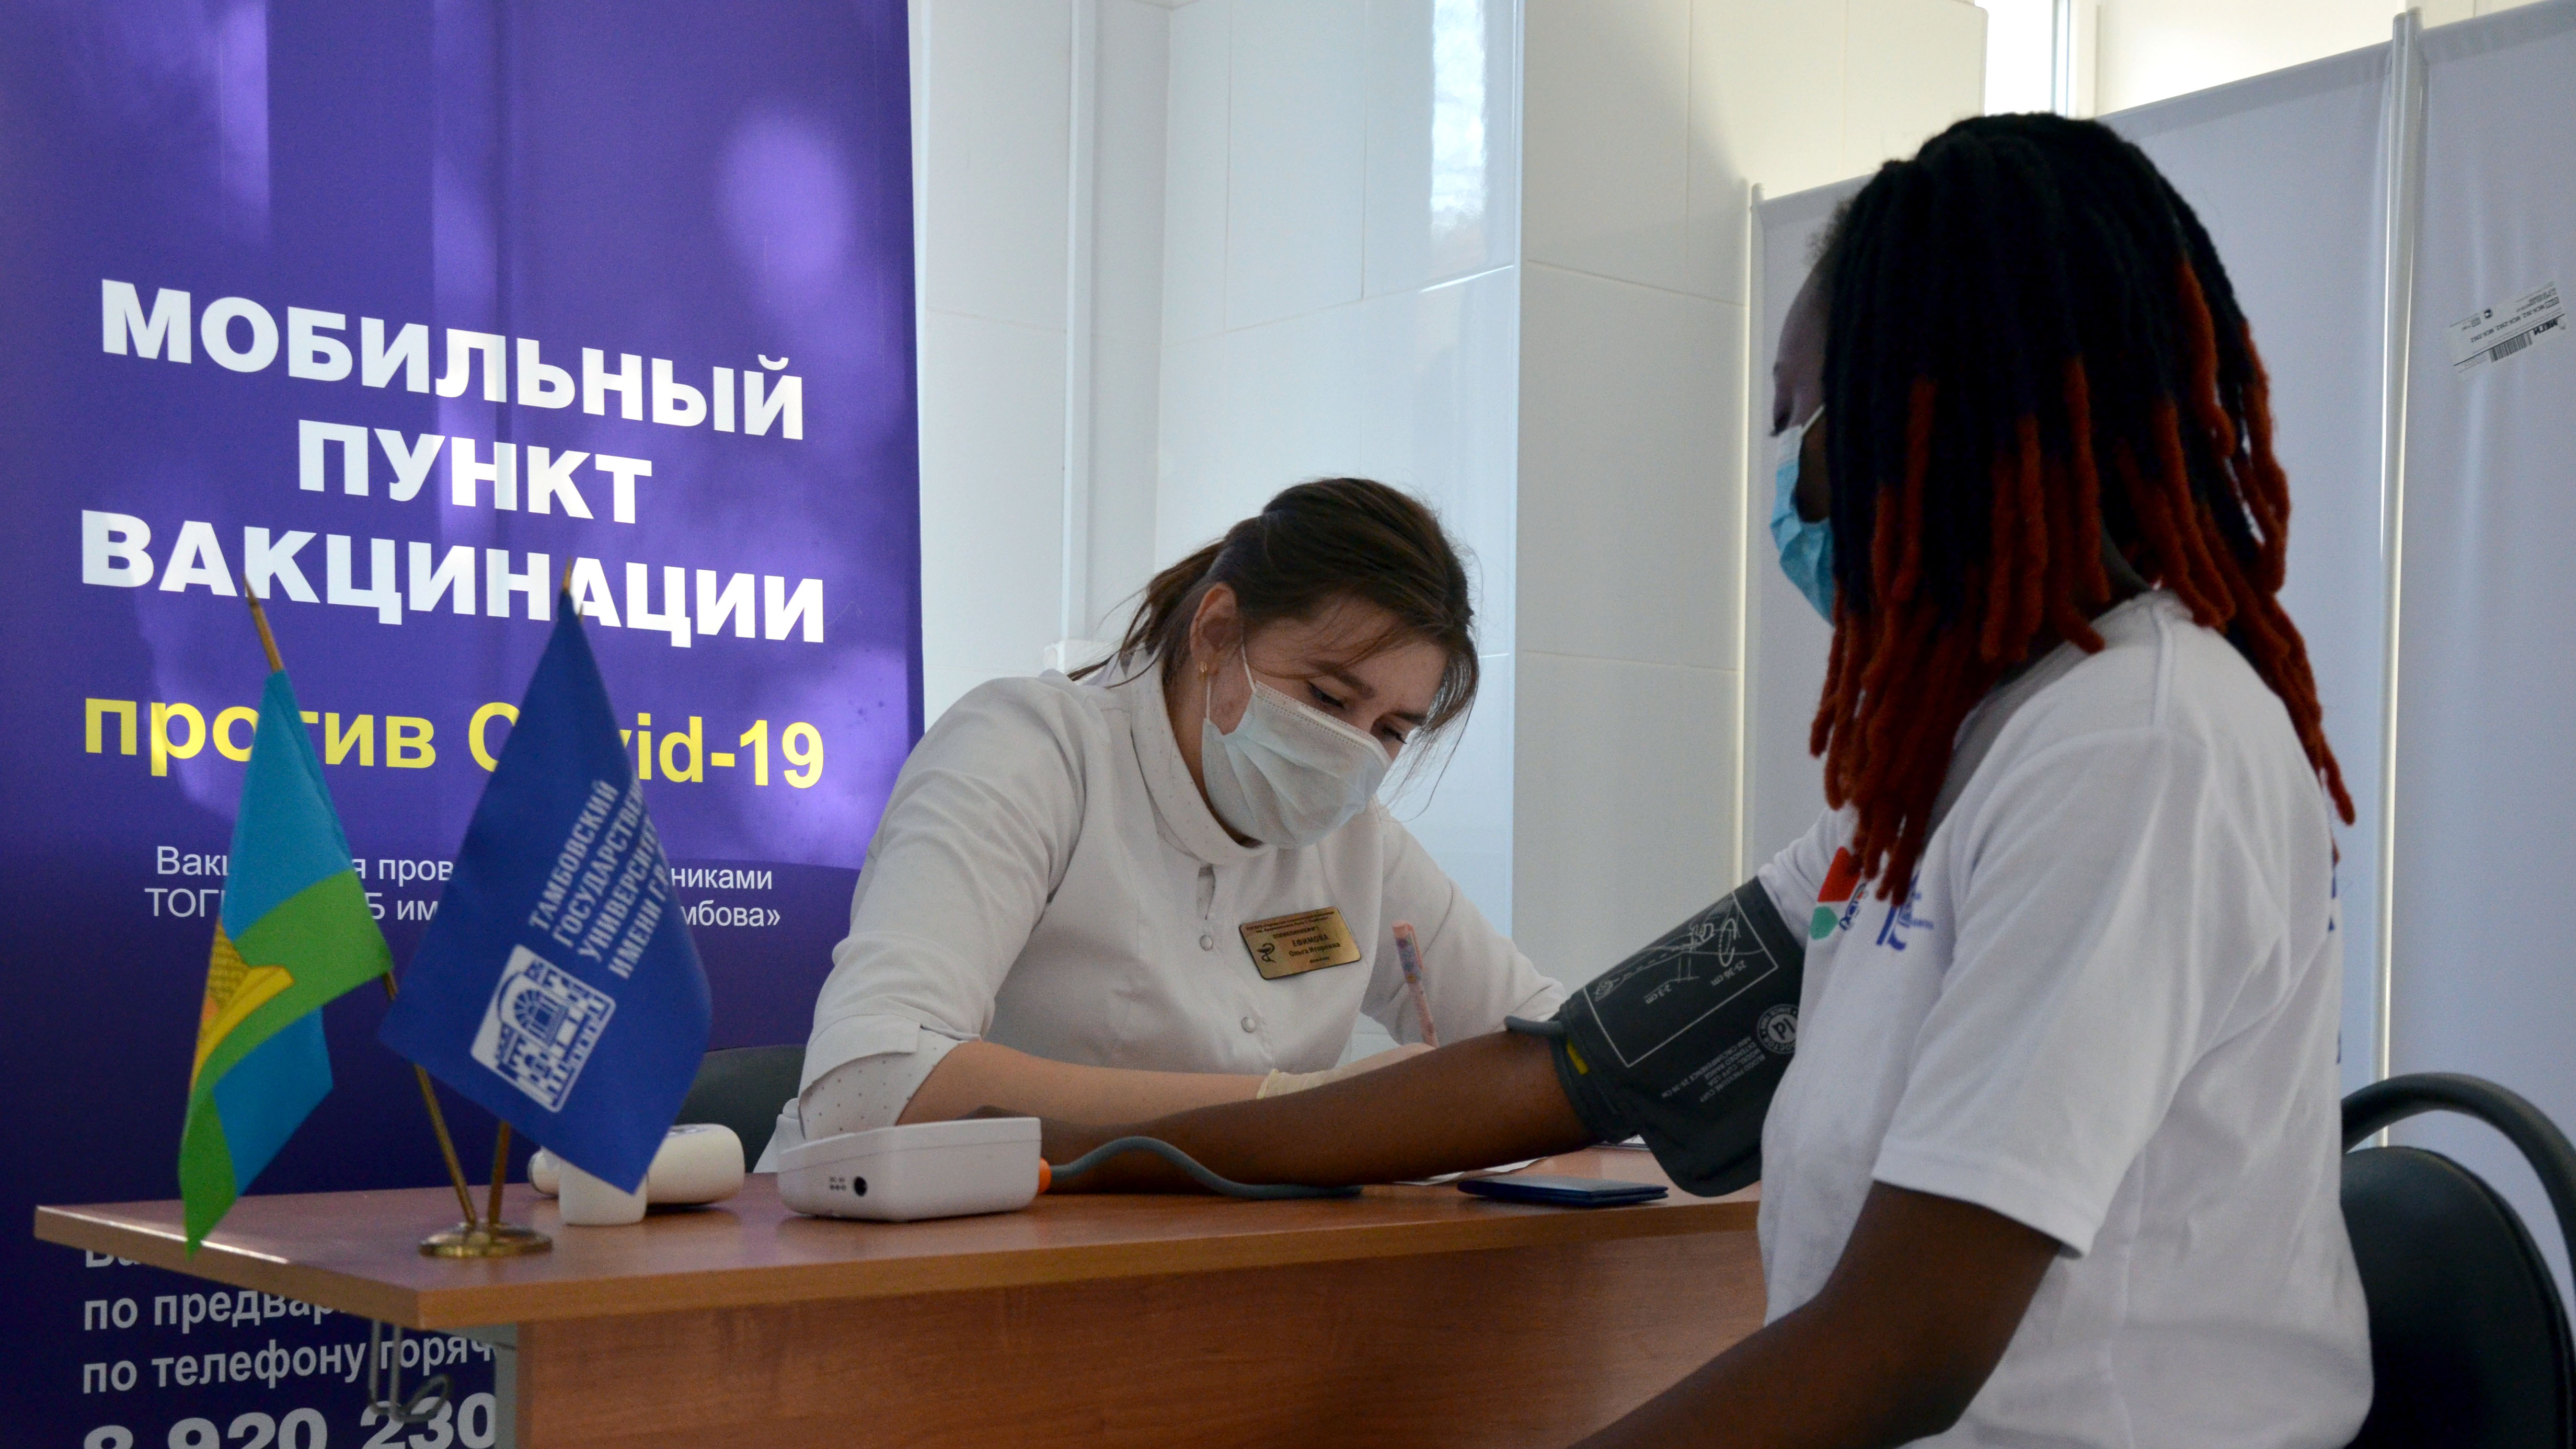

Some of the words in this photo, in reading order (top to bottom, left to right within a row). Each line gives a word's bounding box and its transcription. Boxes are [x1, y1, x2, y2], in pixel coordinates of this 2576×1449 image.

[102, 279, 803, 441] МОБИЛЬНЫЙ
[298, 419, 652, 524] ПУНКТ
[82, 509, 824, 648] ВАКЦИНАЦИИ
[85, 698, 436, 777] проив
[468, 702, 824, 789] Cid-19
[528, 779, 619, 931] ТАМБОВСКИЙ
[607, 898, 662, 979] ИМЕНИ
[681, 900, 780, 927] мбова»
[1289, 947, 1309, 957] Ольга
[1309, 941, 1341, 954] Игоревна
[1292, 934, 1329, 947] ЕФИМОВА
[84, 1297, 138, 1331] по
[83, 1360, 137, 1394] по
[151, 1339, 366, 1389] телефону
[381, 1336, 491, 1376] горяч
